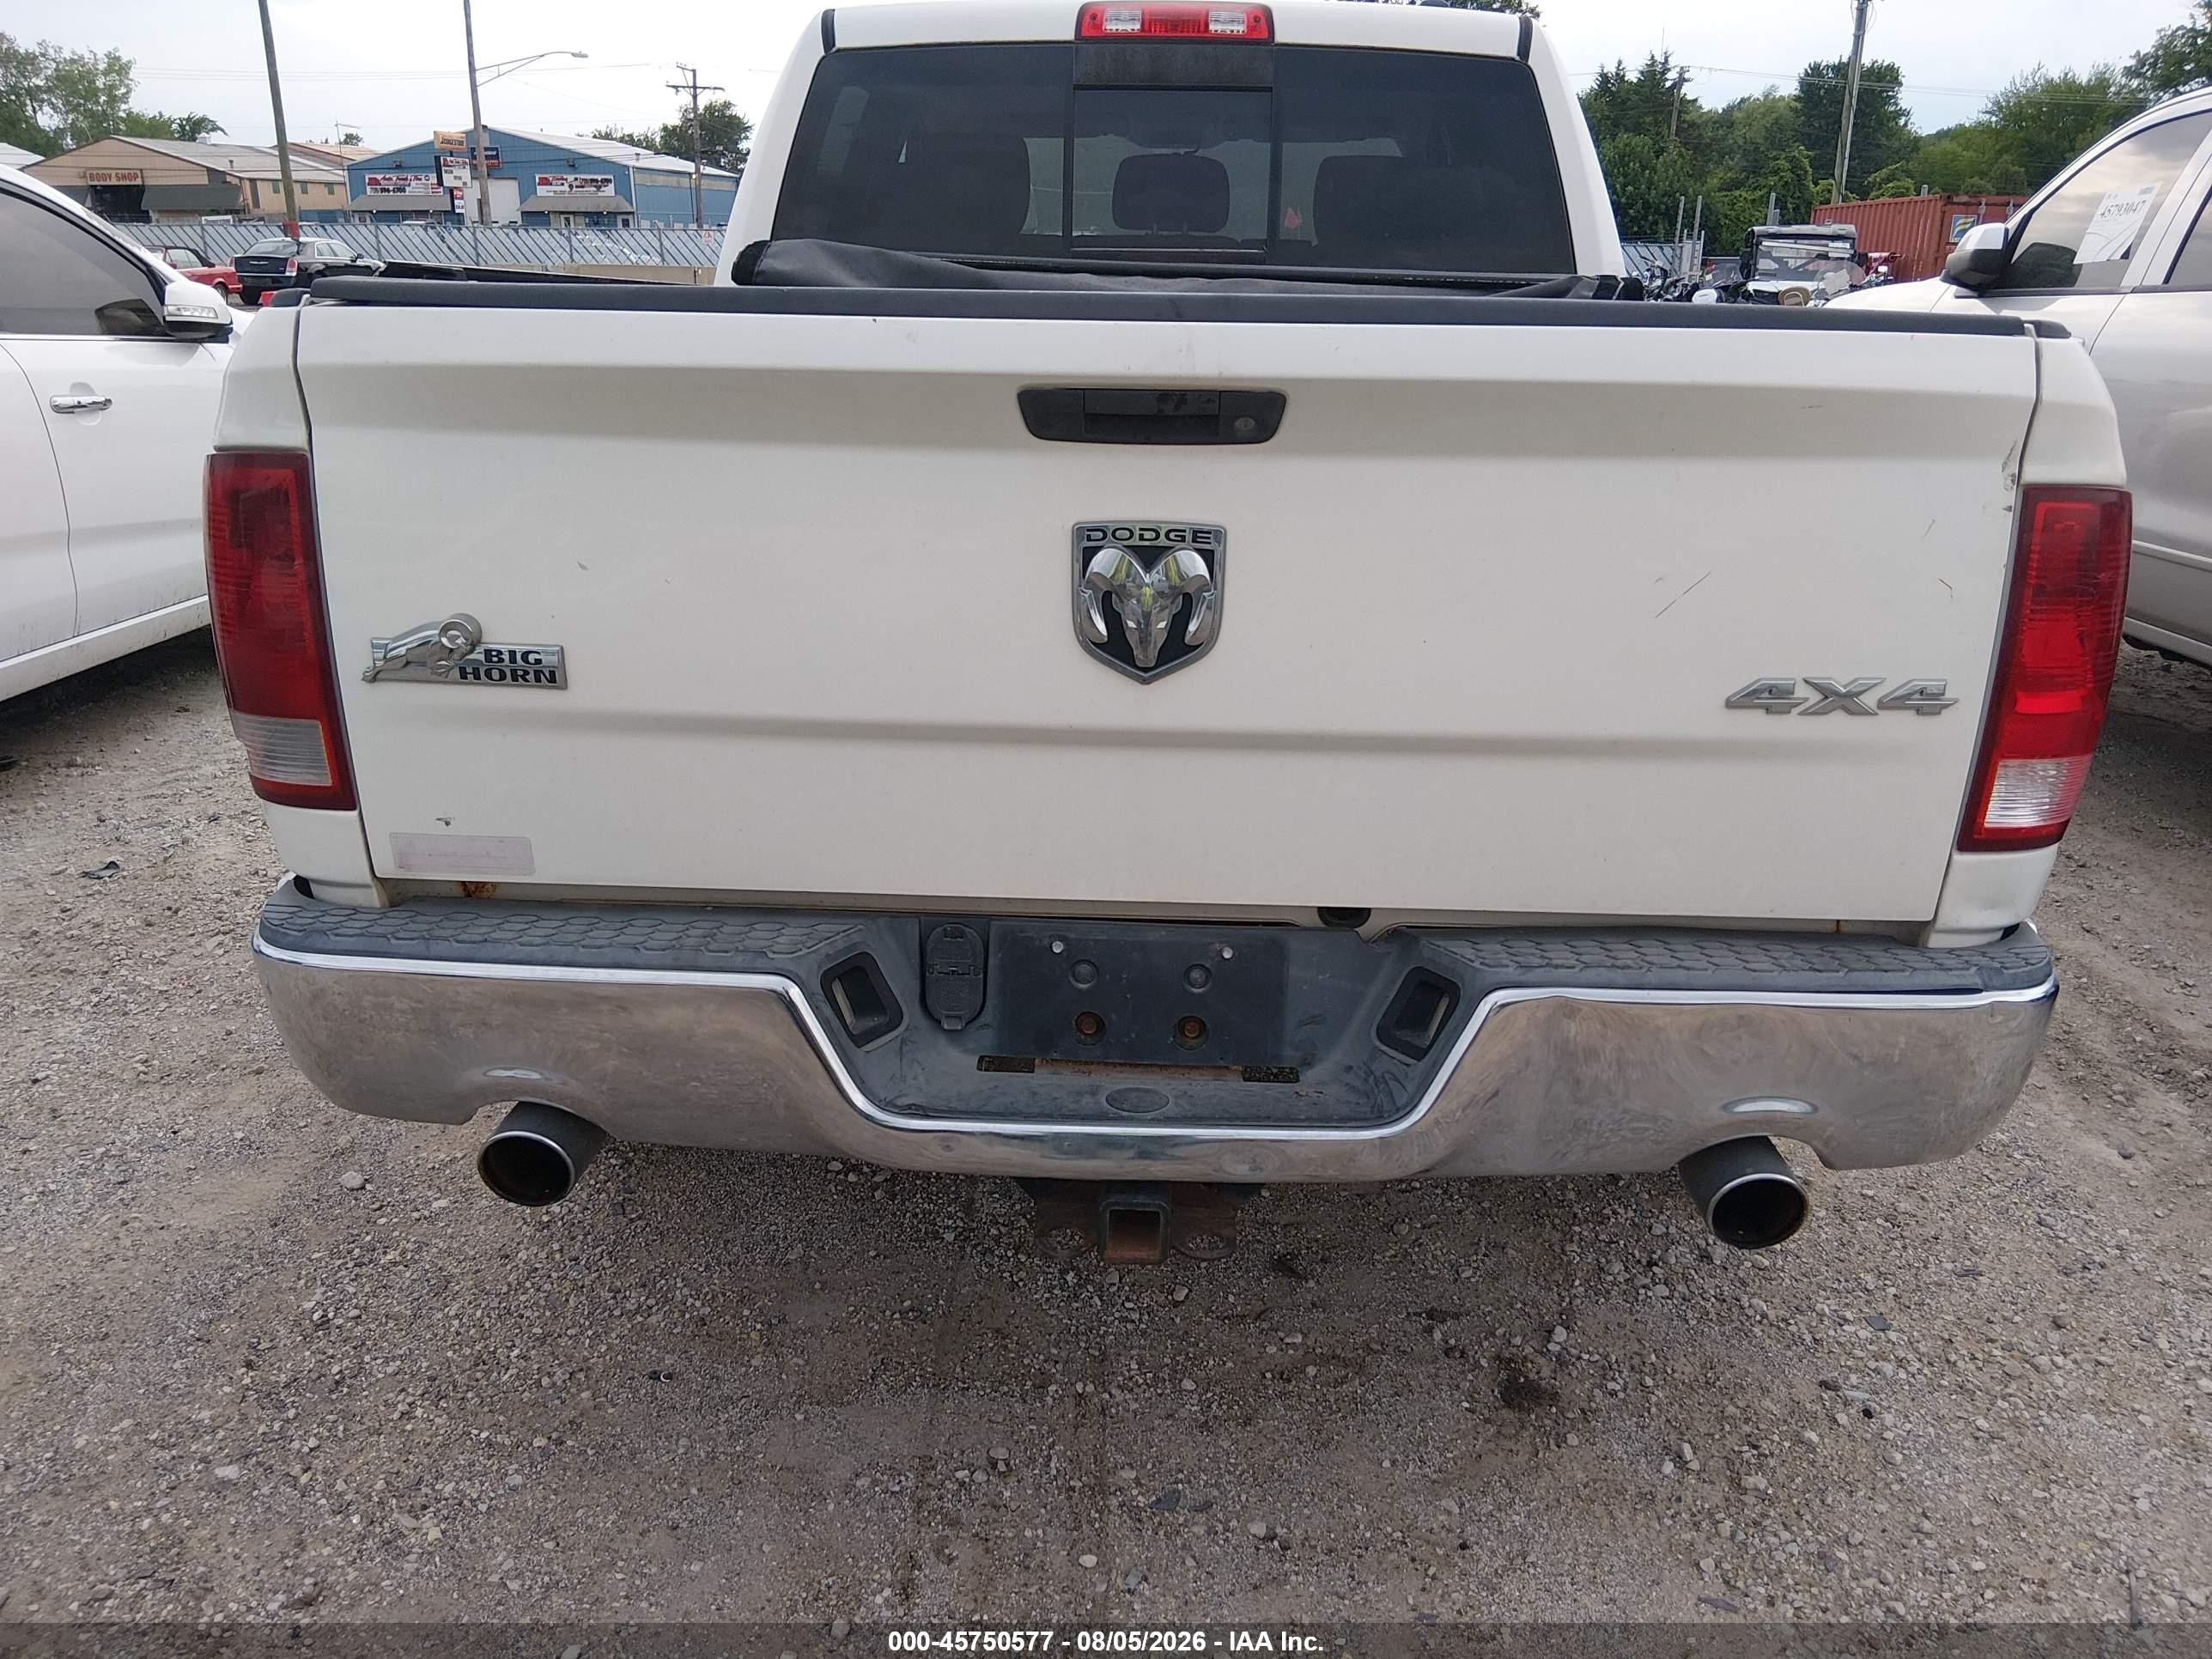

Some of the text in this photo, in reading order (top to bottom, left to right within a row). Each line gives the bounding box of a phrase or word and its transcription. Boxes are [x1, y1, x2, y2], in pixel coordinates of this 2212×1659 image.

[88, 172, 139, 182] BODY SHOP
[1085, 527, 1212, 544] DODGE
[483, 648, 544, 666] BIG
[459, 666, 558, 685] HORN
[1725, 677, 1959, 715] 4X4
